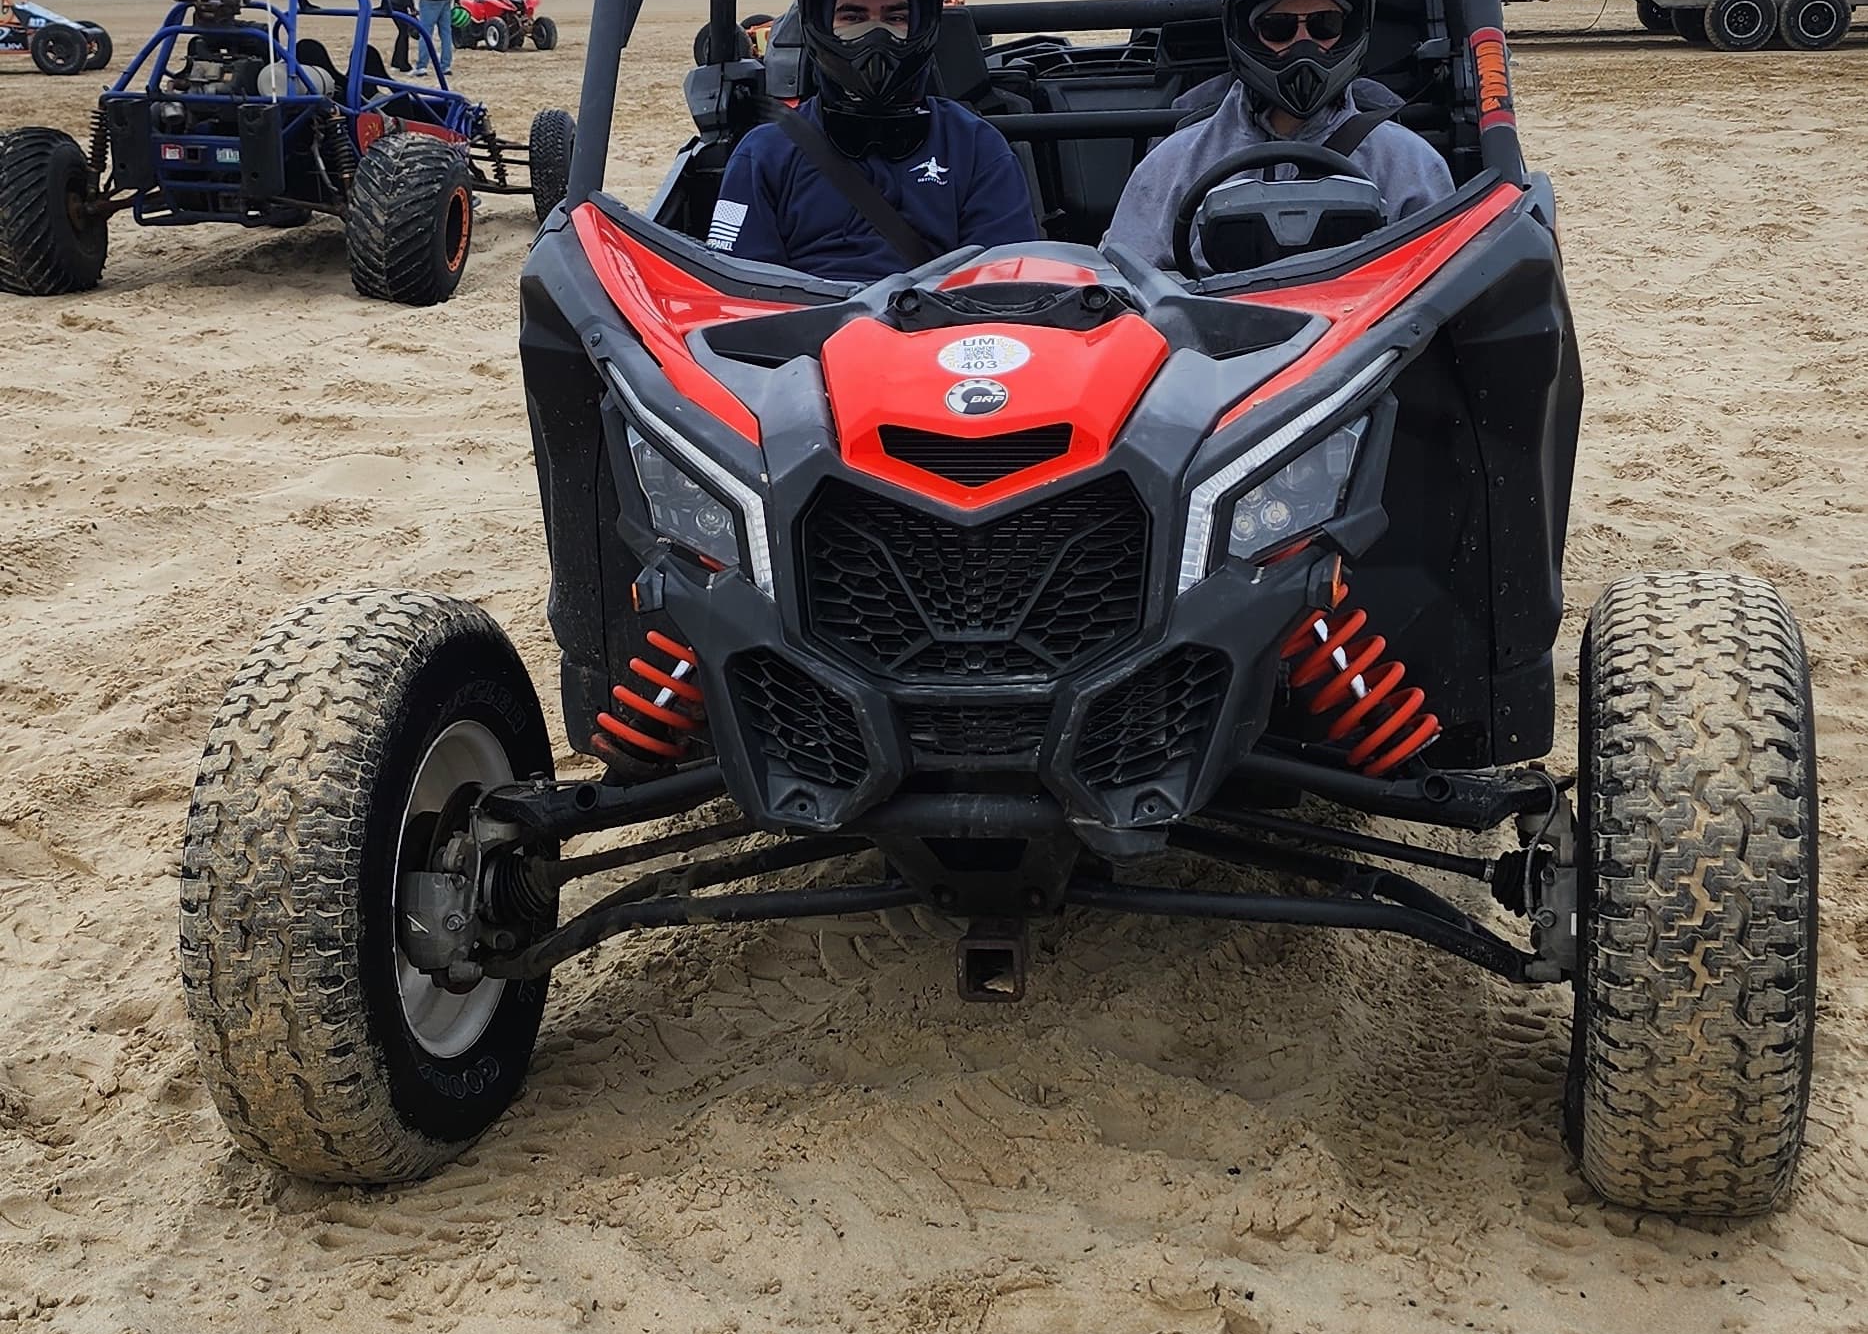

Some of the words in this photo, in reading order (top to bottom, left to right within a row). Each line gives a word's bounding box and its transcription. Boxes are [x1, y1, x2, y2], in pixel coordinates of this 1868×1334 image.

[962, 338, 995, 347] UM
[961, 360, 998, 370] 403
[969, 395, 1005, 404] BRP
